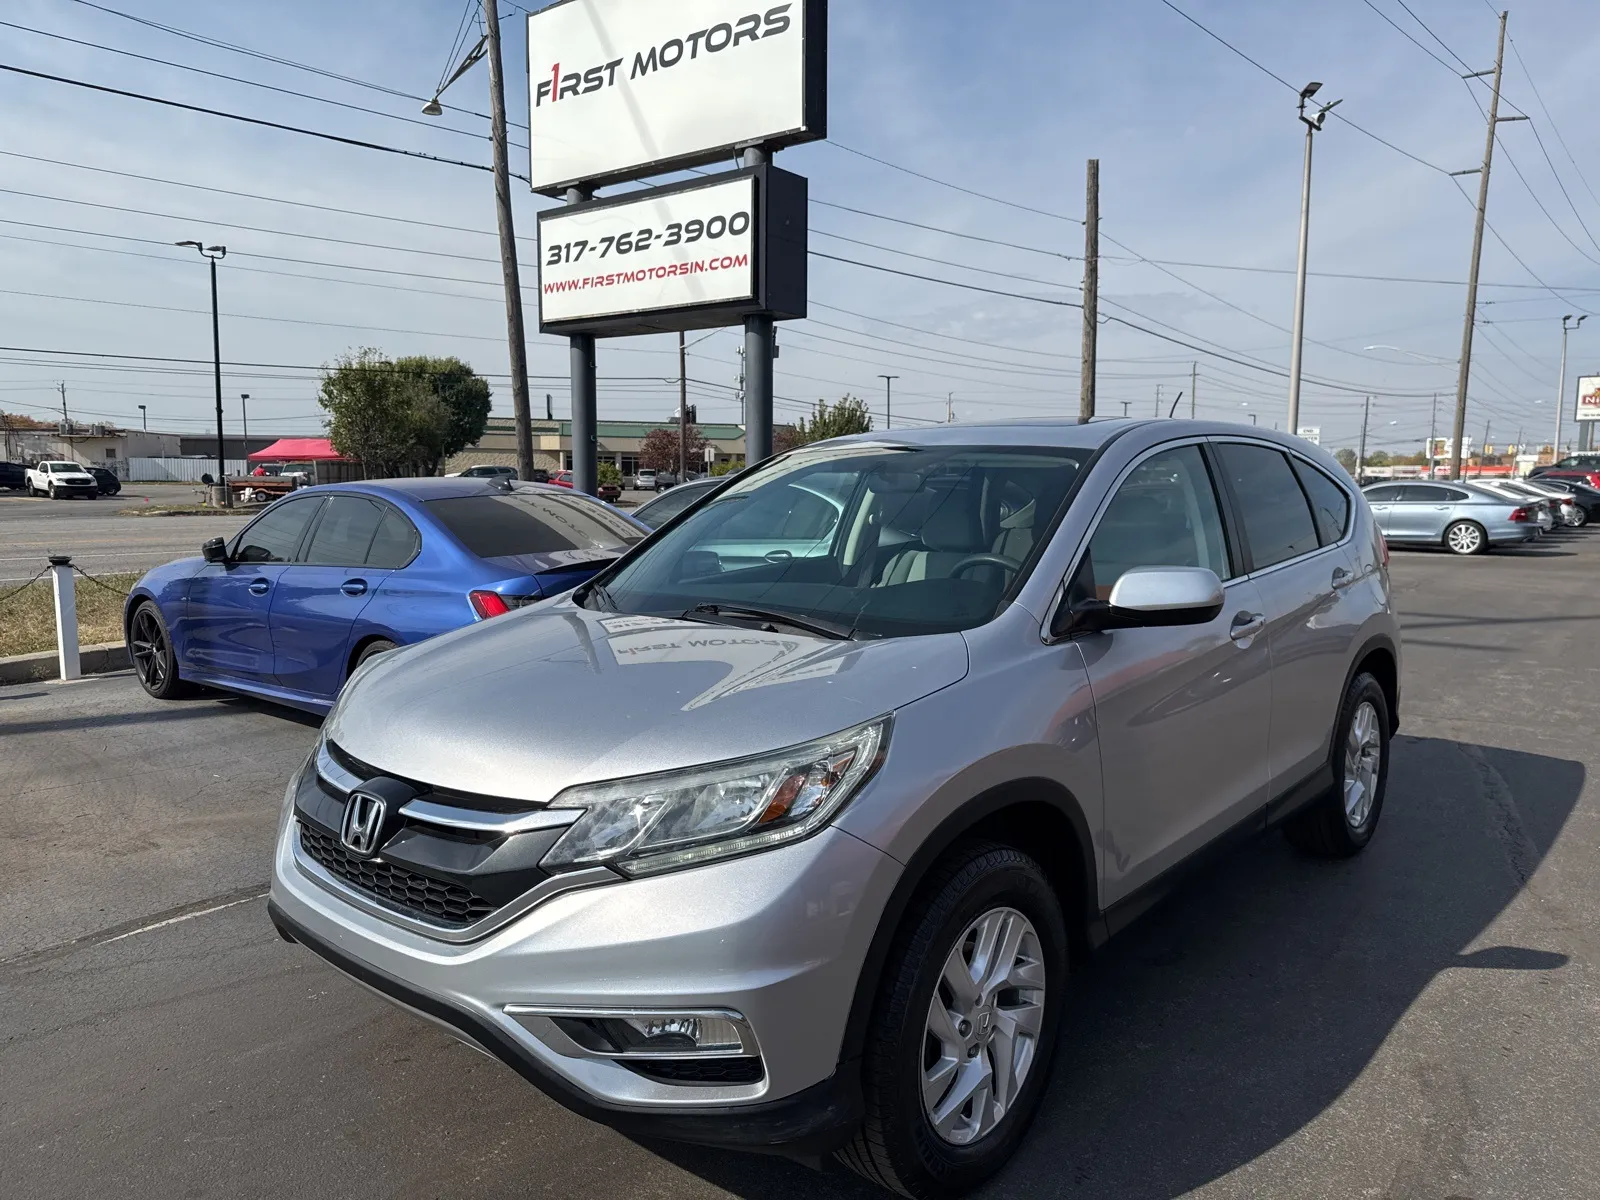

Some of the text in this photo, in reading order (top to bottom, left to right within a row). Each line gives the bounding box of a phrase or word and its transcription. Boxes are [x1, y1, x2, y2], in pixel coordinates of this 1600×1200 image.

[630, 2, 793, 80] MOTORS
[546, 211, 750, 266] 317-762-3900
[544, 253, 748, 295] WWW.FIRSTMOTORSIN.COM
